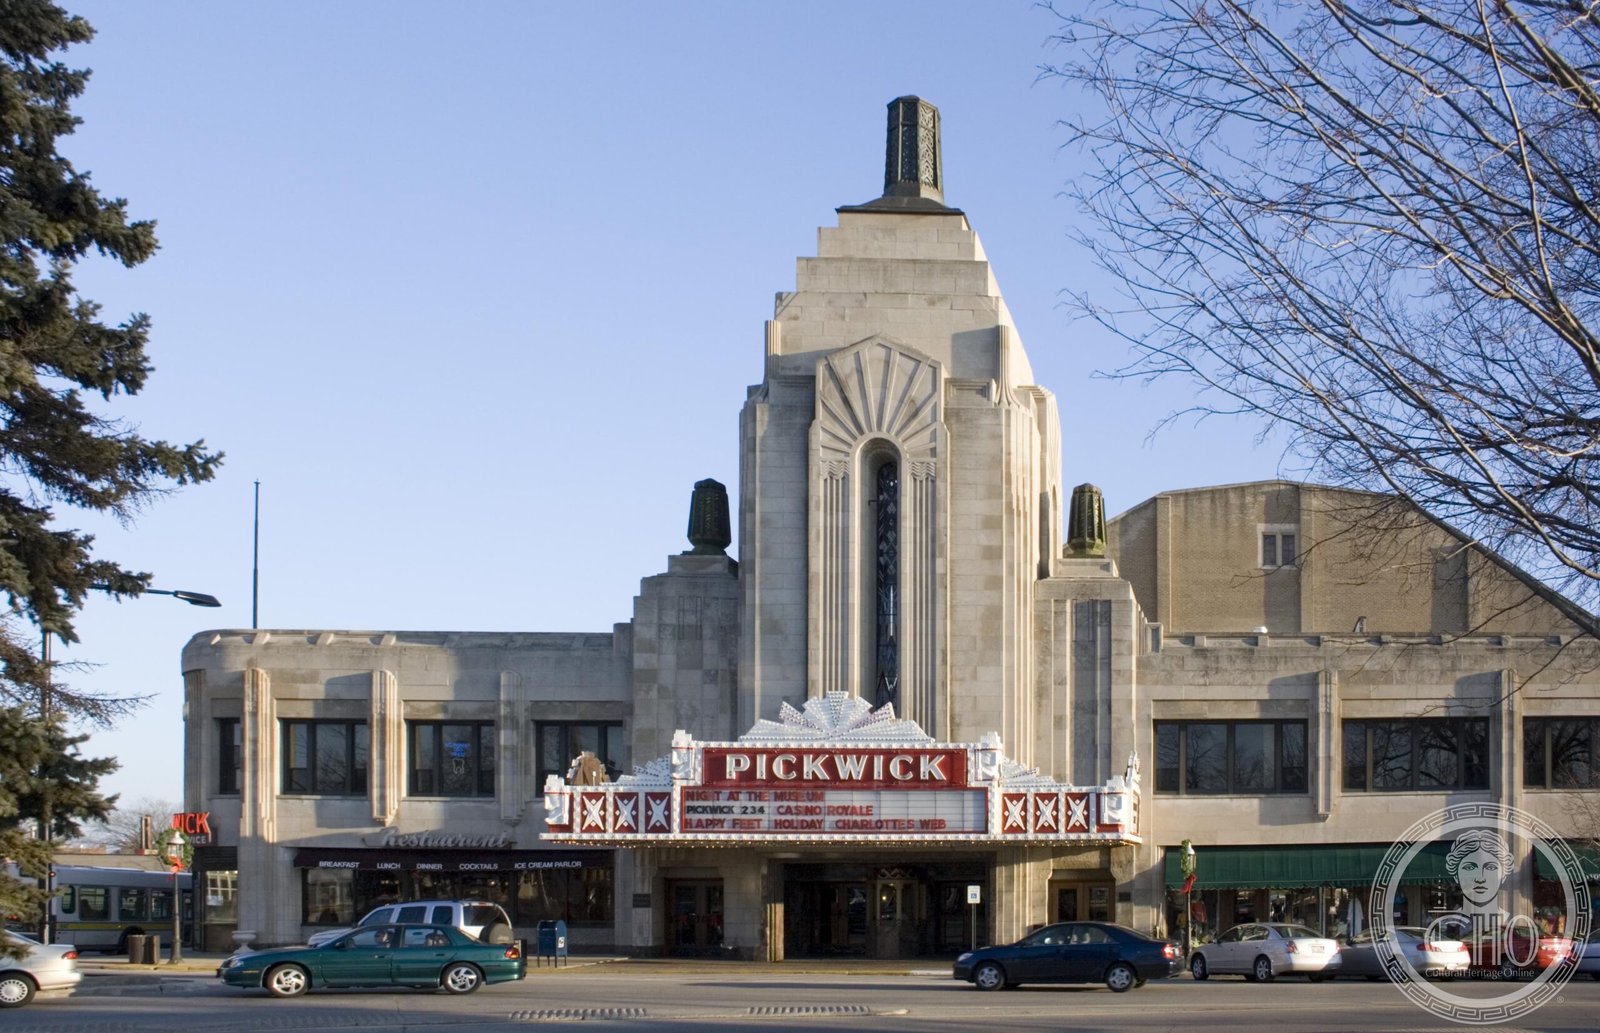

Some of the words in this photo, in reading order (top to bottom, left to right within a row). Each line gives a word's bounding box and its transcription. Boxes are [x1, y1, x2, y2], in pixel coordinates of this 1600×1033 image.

[725, 753, 947, 781] PICKWICK
[686, 790, 722, 801] NIGT
[727, 791, 742, 801] AT
[746, 791, 768, 801] THE
[686, 805, 734, 815] PICKWICK
[827, 804, 874, 816] ROYALE
[685, 818, 726, 829] HAPPY
[732, 818, 762, 829] FEET
[919, 818, 947, 830] WEB
[378, 826, 512, 848] Restaurant
[318, 860, 360, 869] BREAKFAST
[376, 862, 401, 870] LUNCH
[528, 861, 553, 869] CREAM
[554, 860, 582, 868] PARLOR
